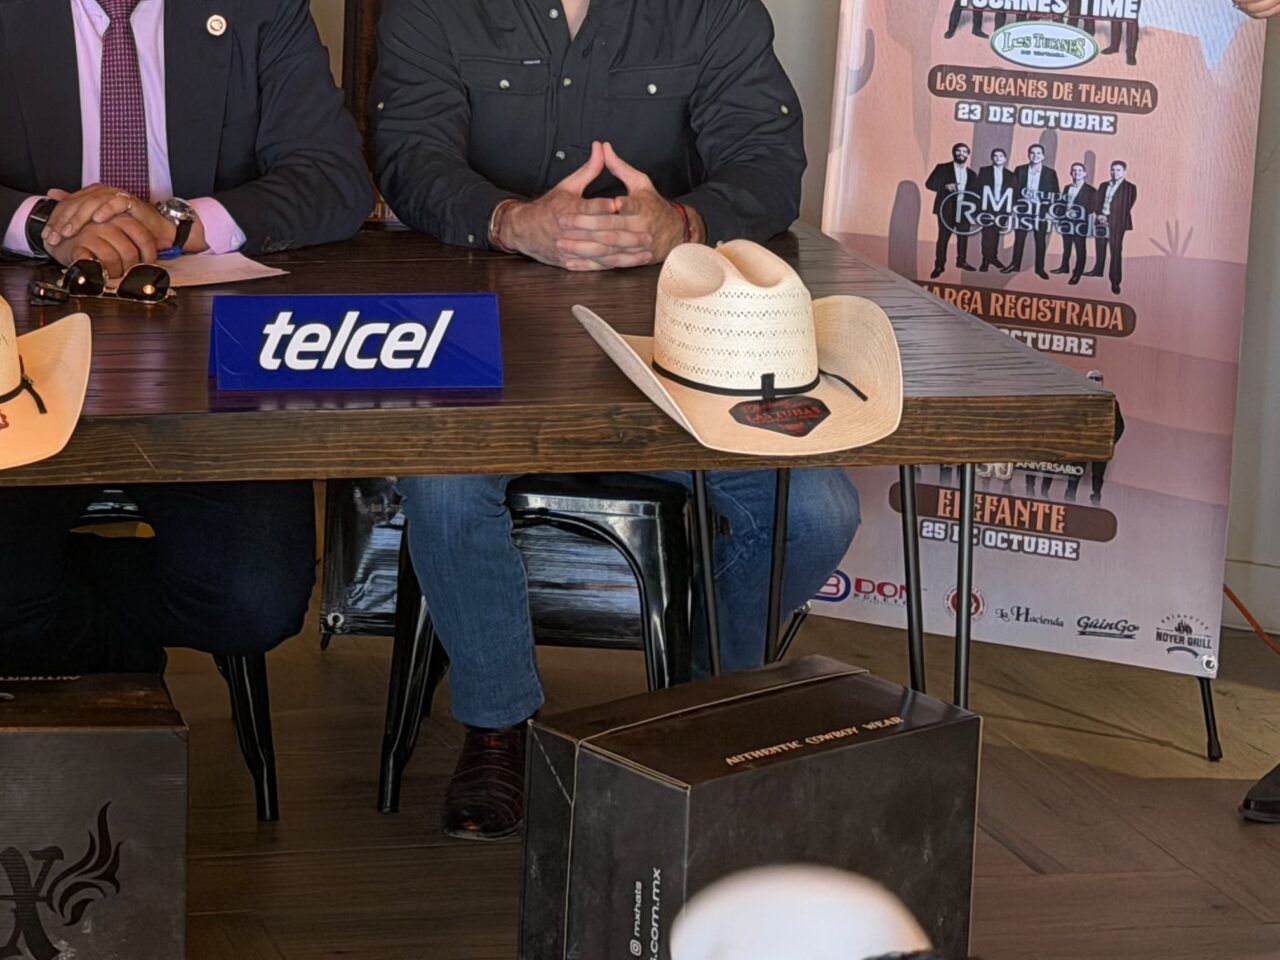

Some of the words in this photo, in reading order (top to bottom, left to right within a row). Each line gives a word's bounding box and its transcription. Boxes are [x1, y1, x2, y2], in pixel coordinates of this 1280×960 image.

[936, 72, 967, 92] LOS
[972, 74, 1048, 100] TUCANES
[1052, 81, 1074, 100] DE
[1078, 84, 1153, 109] TIJUANA
[957, 103, 982, 120] 23
[988, 105, 1014, 123] DE
[1021, 109, 1115, 132] OCTUBRE
[955, 200, 1110, 238] Registrada
[981, 185, 1086, 221] Marca
[990, 292, 1124, 331] REGISTRADA
[259, 310, 455, 370] telcel
[922, 522, 946, 539] 25
[985, 531, 1078, 558] OCTUBRE
[1010, 606, 1064, 627] Hacienda
[725, 740, 803, 767] AUTHENTIC
[805, 726, 860, 745] COWBOY
[862, 715, 904, 731] WEAR
[633, 881, 642, 937] mxhats
